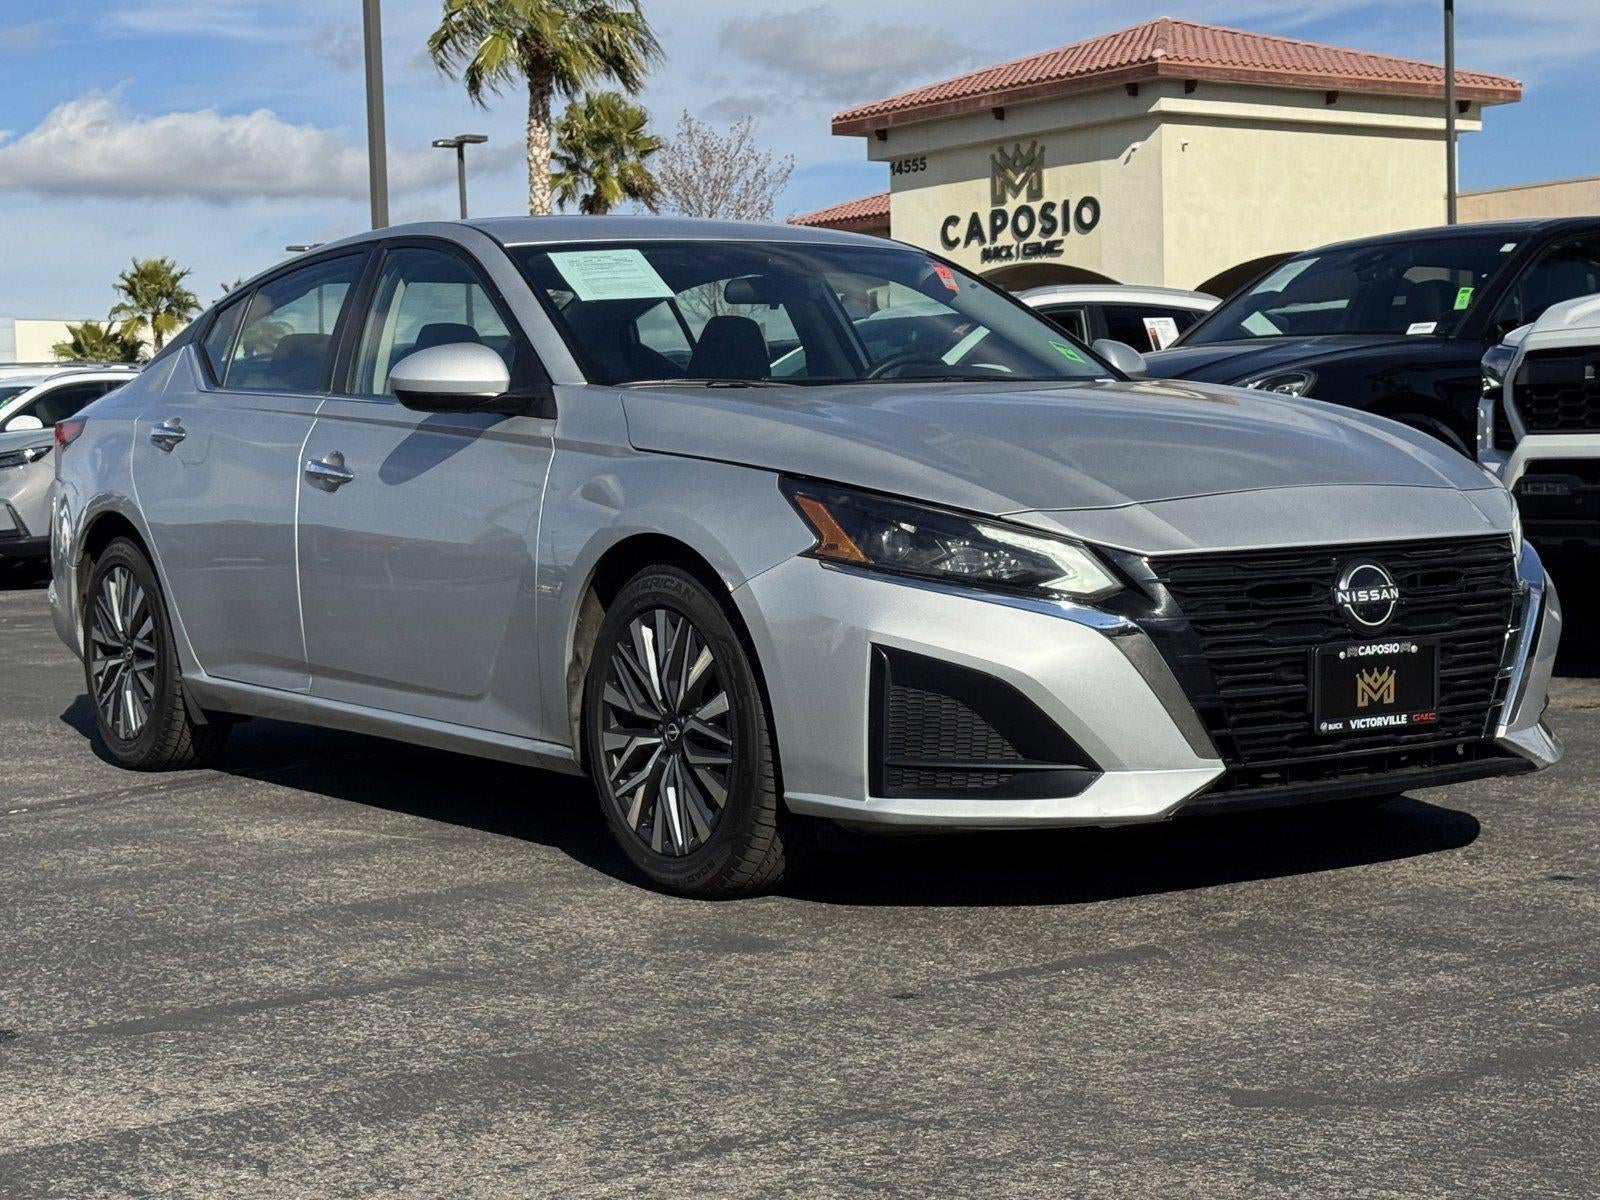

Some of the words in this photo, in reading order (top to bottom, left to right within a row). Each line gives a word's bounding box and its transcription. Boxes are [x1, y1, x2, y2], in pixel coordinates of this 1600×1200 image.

[940, 196, 1100, 250] CAPOSIO
[1021, 239, 1064, 260] GMC
[1337, 588, 1399, 603] NISSAN
[1358, 643, 1400, 656] CAPOSIO
[1328, 722, 1343, 730] BUICK
[1350, 714, 1408, 729] VICTORVILLE
[1412, 712, 1436, 721] GMC
